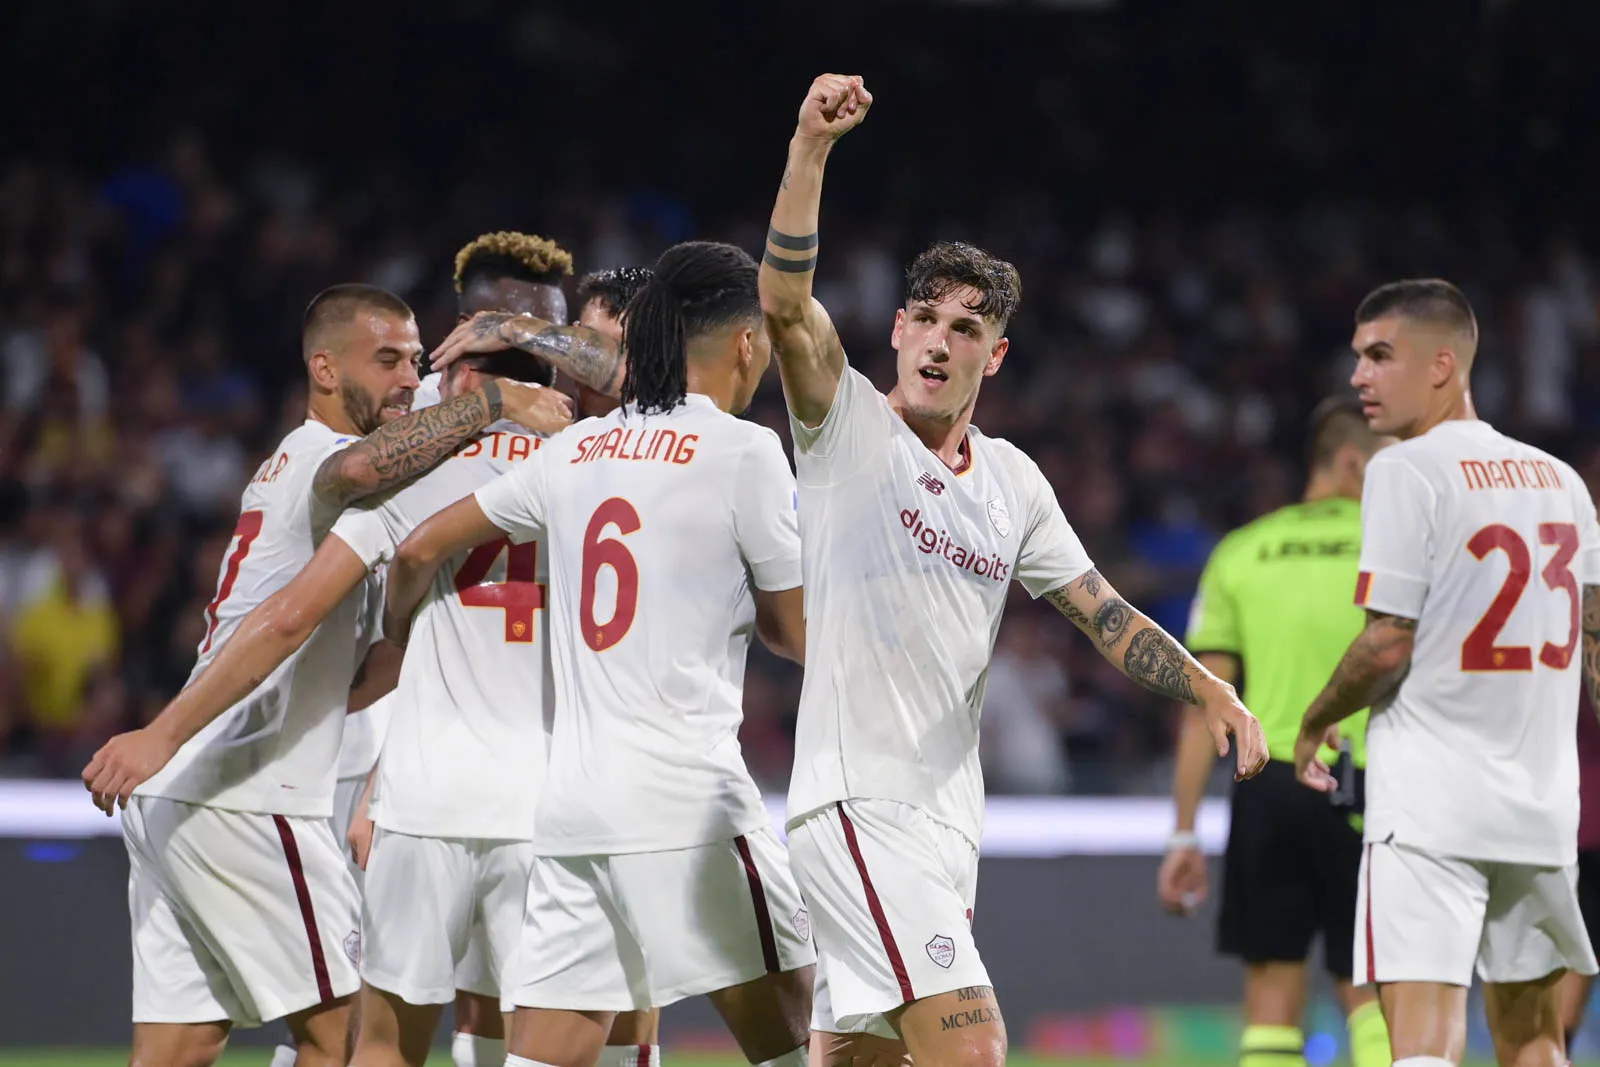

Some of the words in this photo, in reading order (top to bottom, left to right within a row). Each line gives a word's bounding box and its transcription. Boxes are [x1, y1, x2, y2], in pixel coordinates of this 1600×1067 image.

[570, 427, 700, 465] SMALLING
[1459, 460, 1566, 490] MANCINI
[453, 533, 547, 644] 4
[579, 496, 642, 653] 6
[900, 508, 1010, 582] digitalbits
[1459, 522, 1581, 673] 23
